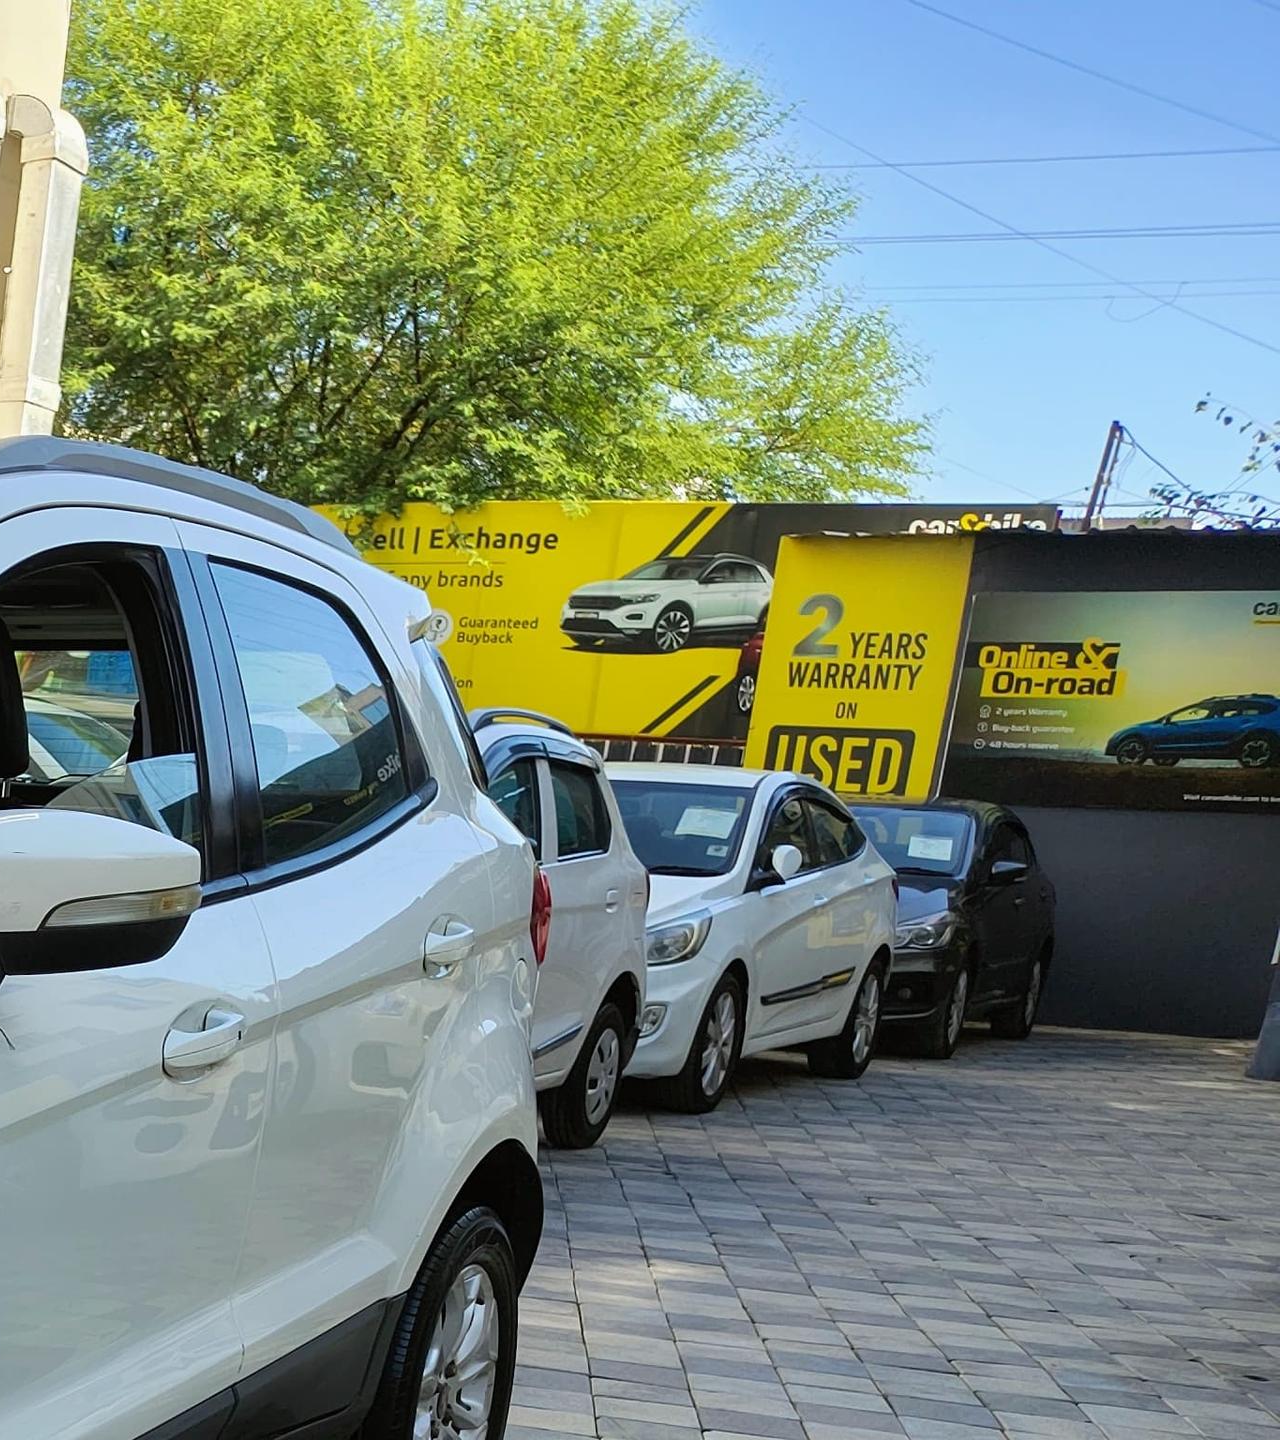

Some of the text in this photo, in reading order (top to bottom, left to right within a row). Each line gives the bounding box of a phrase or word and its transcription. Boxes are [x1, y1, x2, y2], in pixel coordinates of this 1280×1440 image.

[372, 526, 405, 550] ell
[437, 570, 504, 588] brands
[458, 616, 539, 630] Guaranteed
[792, 593, 928, 660] 2 YEARS
[456, 631, 514, 646] Buyback
[978, 637, 1121, 670] Online &
[788, 661, 922, 690] WARRANTY
[992, 671, 1117, 696] On-road
[835, 701, 858, 719] ON
[1003, 708, 1027, 717] years
[775, 734, 903, 794] USED
